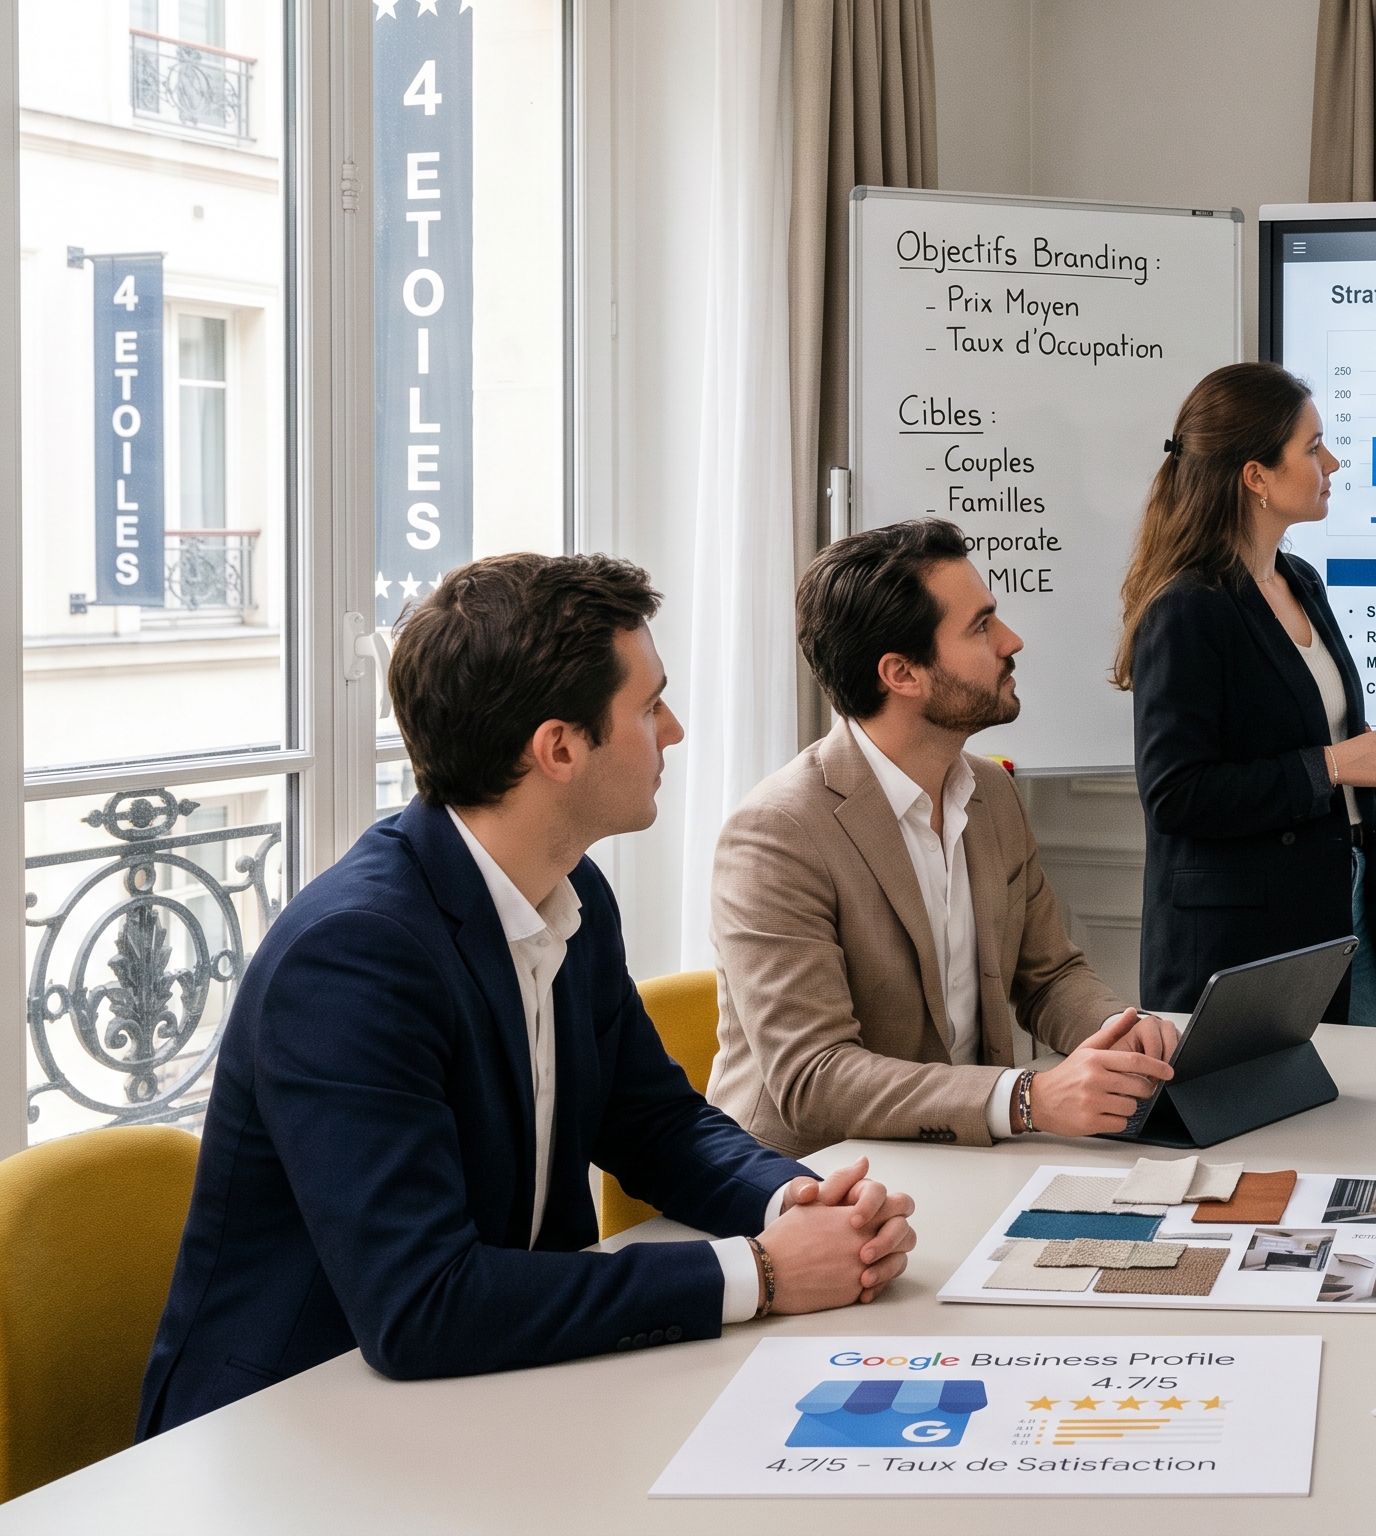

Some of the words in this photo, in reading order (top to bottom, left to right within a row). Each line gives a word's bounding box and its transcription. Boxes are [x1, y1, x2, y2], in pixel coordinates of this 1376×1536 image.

[404, 60, 442, 115] 4
[896, 230, 1017, 273] Objectifs
[1033, 237, 1148, 285] Branding
[114, 275, 138, 311] 4
[949, 285, 992, 313] Prix
[1007, 289, 1078, 326] Moyen
[403, 152, 444, 550] ETOILES
[947, 327, 1003, 352] Taux
[1016, 328, 1162, 366] d'Occupation
[1334, 366, 1352, 376] 250
[1334, 389, 1352, 399] 200
[898, 394, 982, 426] Cibles
[1335, 412, 1352, 423] 150
[1335, 436, 1352, 446] 100
[113, 331, 141, 585] ETOILES
[945, 445, 1034, 481] Couples
[950, 486, 1045, 513] Familles
[1344, 482, 1351, 491] 0
[963, 528, 1062, 559] orporate
[989, 569, 1053, 593] MICE
[829, 1351, 960, 1371] Google
[972, 1353, 1117, 1366] Business
[1129, 1352, 1235, 1366] Profile
[1091, 1376, 1178, 1390] 4.7/5
[901, 1420, 952, 1443] G
[766, 1458, 847, 1471] 4.7/5
[884, 1458, 955, 1471] Taux
[967, 1458, 1007, 1471] de
[1018, 1457, 1215, 1471] Satisfaction
